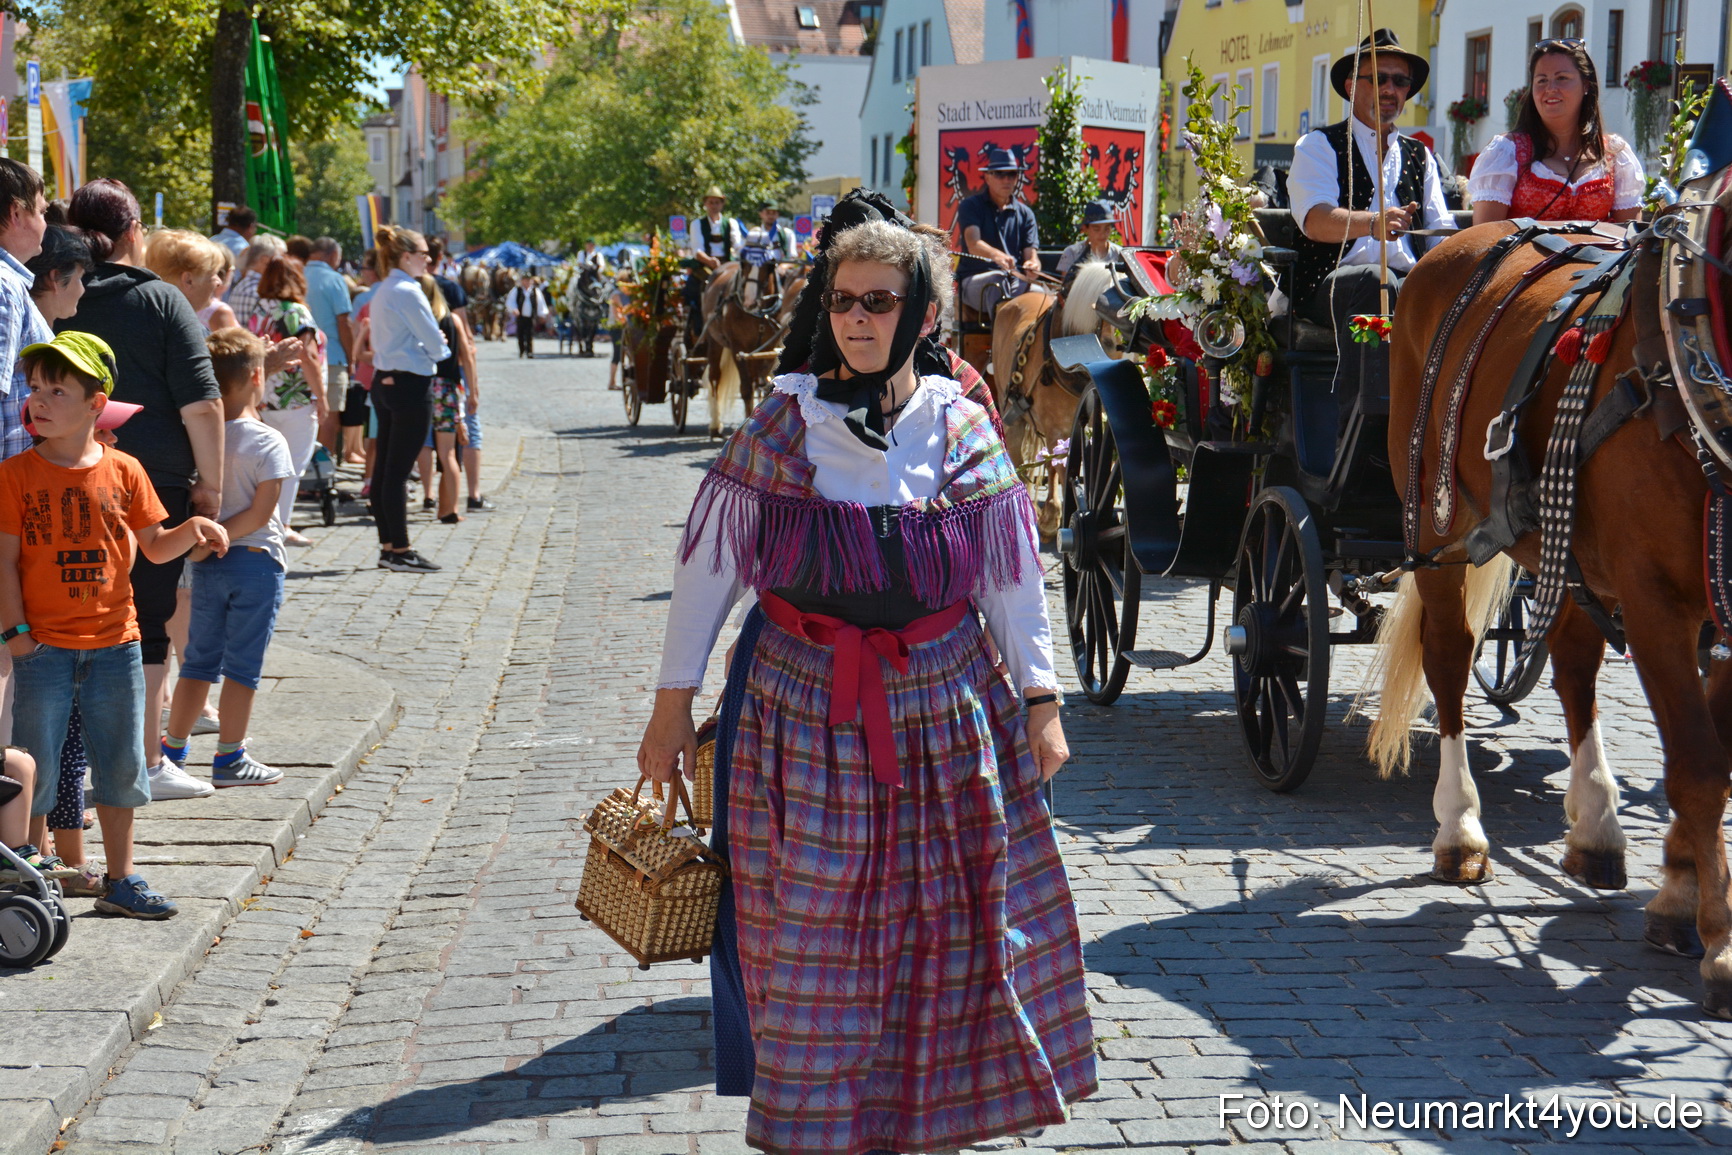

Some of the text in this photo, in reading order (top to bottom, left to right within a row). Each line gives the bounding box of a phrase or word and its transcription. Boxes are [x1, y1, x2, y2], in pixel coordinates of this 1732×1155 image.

[1220, 34, 1250, 64] HOTEL
[938, 97, 1041, 123] Stadt Neumarkt
[1081, 97, 1147, 123] Stadt Neumarkt
[63, 551, 104, 562] PRO
